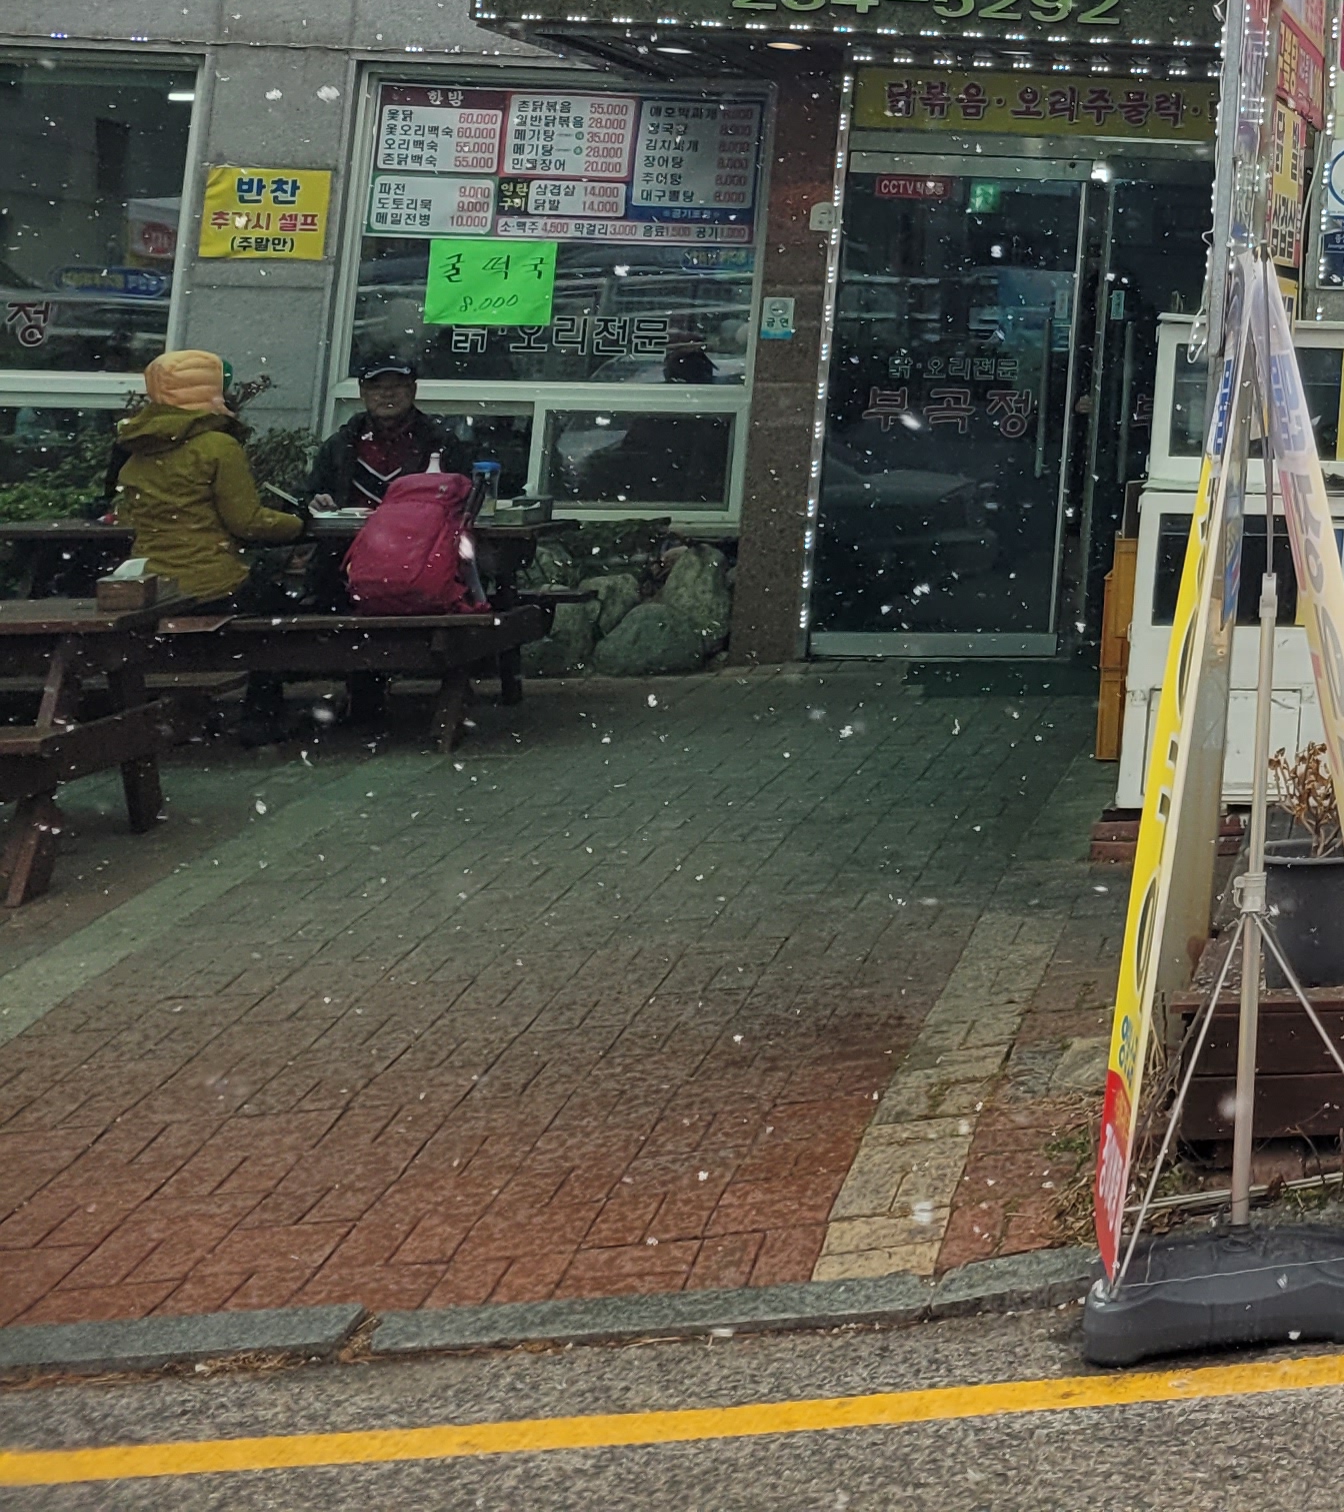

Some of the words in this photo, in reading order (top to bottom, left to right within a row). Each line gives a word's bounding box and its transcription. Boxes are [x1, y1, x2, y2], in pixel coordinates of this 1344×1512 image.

[514, 129, 555, 143] 메기탕
[384, 139, 438, 152] 오리백숙
[512, 143, 554, 157] 메기탕
[643, 155, 683, 169] 장어탕
[237, 177, 301, 205] 반찬
[379, 183, 406, 196] 파전
[377, 198, 432, 212] 도토리묵
[279, 213, 319, 232] 셀프
[375, 212, 431, 226] 메밀전병
[230, 236, 295, 253] (주말만)
[458, 294, 519, 313] 8.000
